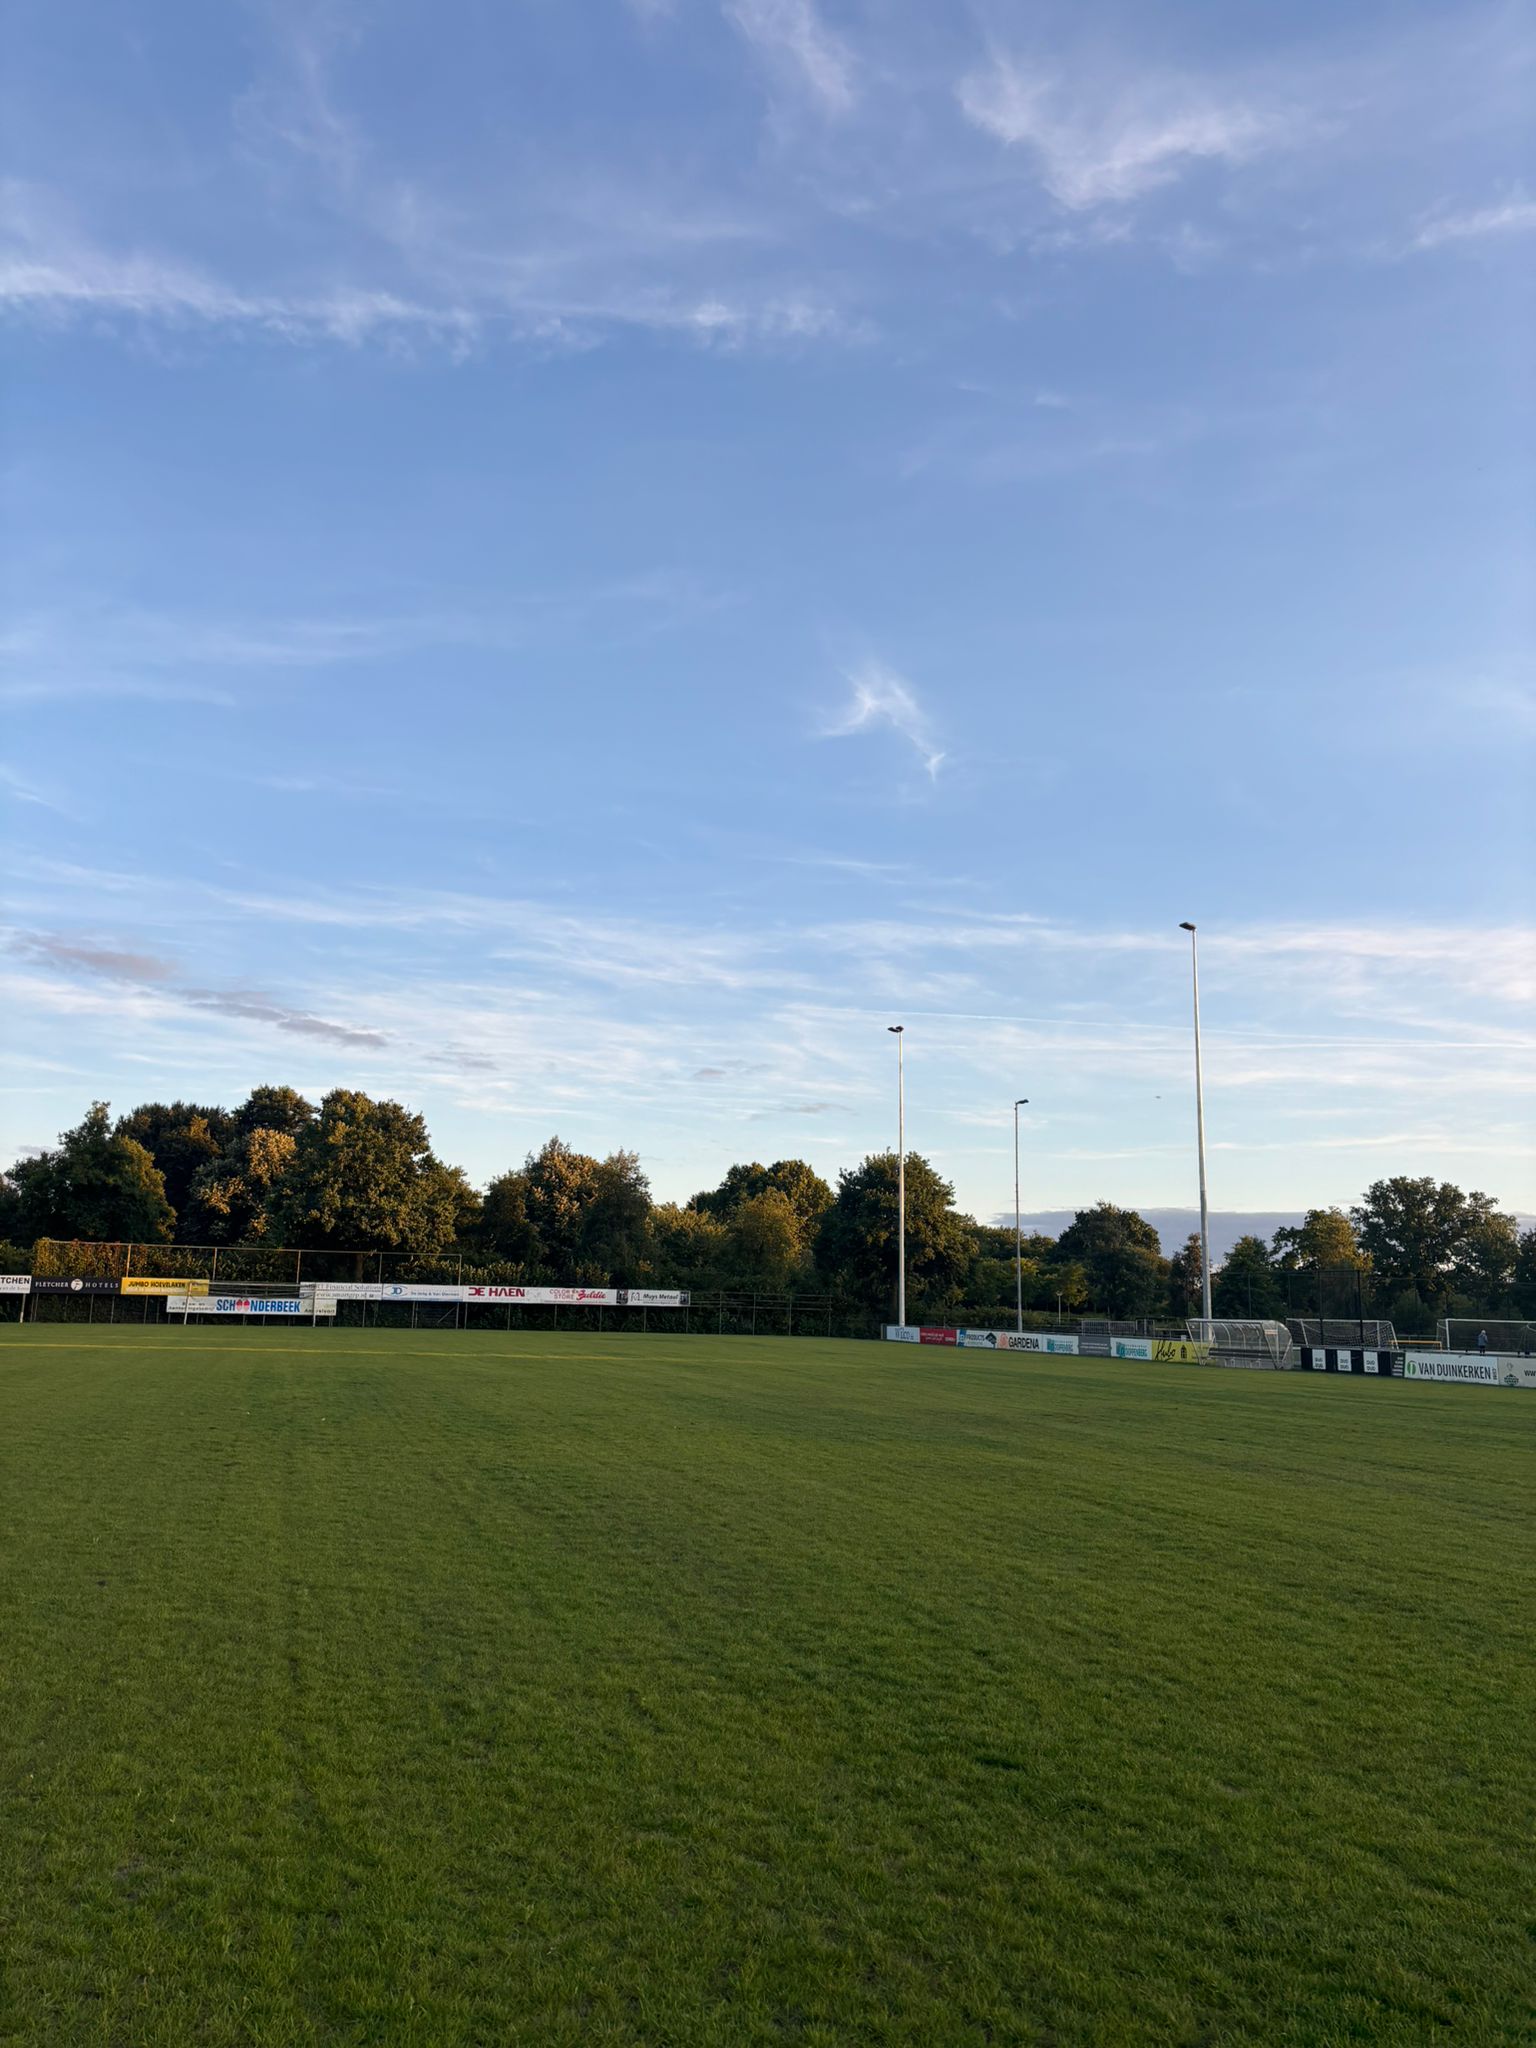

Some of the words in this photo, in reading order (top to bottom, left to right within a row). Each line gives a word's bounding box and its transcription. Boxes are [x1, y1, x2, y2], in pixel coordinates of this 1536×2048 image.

[489, 1287, 525, 1297] HAEN
[1008, 1336, 1040, 1350] GARDENA
[1418, 1362, 1435, 1376] VAN
[1436, 1363, 1491, 1380] DUINKERKEN
